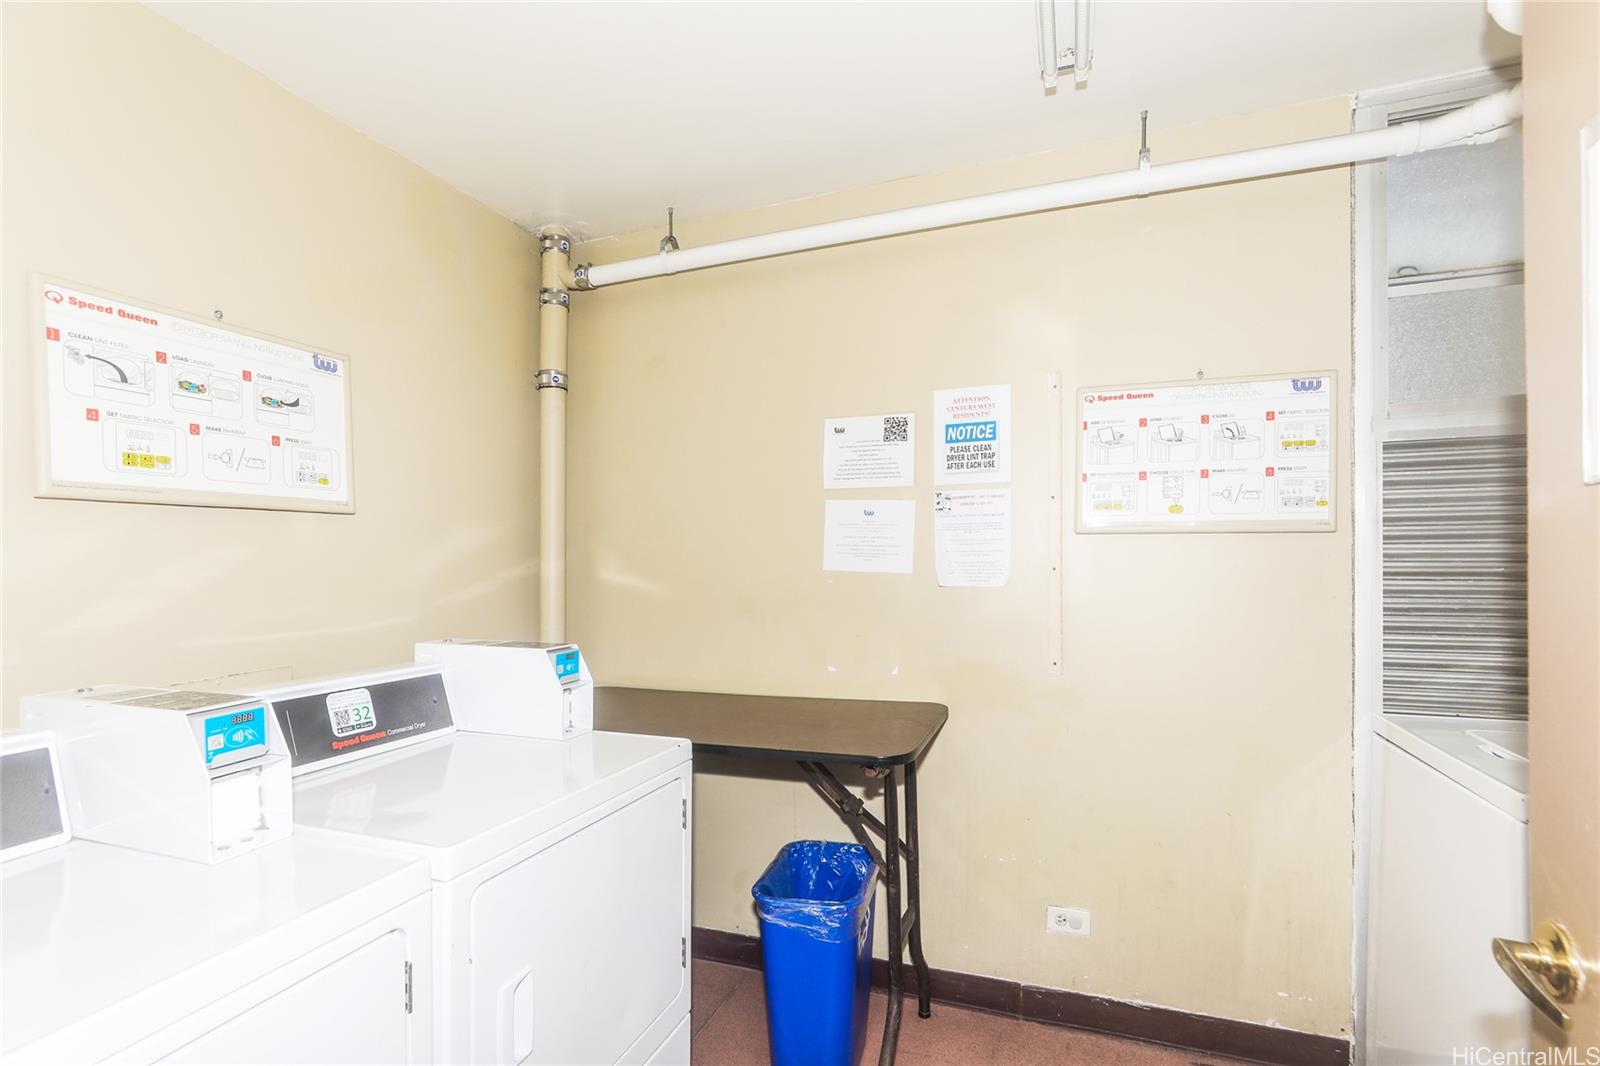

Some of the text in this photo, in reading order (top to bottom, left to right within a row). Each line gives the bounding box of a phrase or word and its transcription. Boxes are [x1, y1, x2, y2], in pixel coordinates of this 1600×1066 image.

[68, 296, 113, 315] Speed
[117, 308, 158, 326] Queen
[67, 331, 93, 342] CLEAN
[172, 354, 189, 363] LOAD
[953, 395, 991, 404] ATTENTION
[1097, 393, 1124, 402] Speed
[1126, 392, 1154, 400] Queen
[107, 410, 118, 418] SET
[205, 425, 221, 433] MAKE
[947, 423, 995, 441] NOTICE
[950, 443, 992, 453] PLEASE CLEAN
[946, 452, 996, 462] DRYER LINT TRAP
[946, 460, 995, 470] AFTER EACH USE
[352, 705, 372, 722] 32
[331, 735, 360, 750] Speed
[360, 731, 386, 743] Queen
[386, 724, 414, 736] Commercial
[414, 721, 426, 730] Dryer
